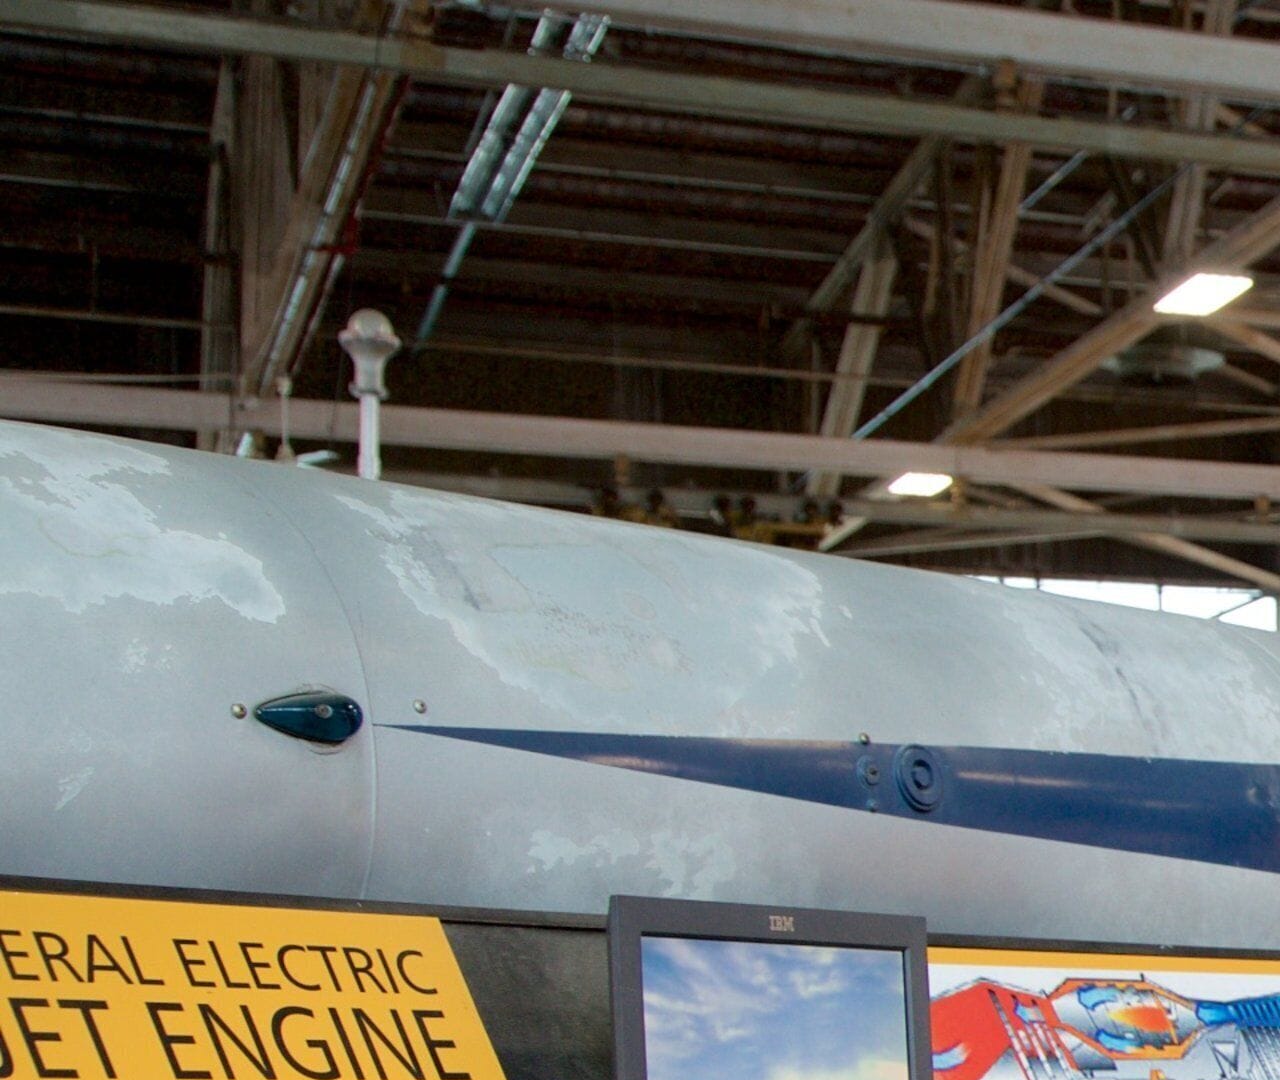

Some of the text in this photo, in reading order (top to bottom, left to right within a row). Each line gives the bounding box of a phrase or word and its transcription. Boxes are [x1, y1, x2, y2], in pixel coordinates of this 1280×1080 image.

[768, 915, 795, 932] IBM
[172, 938, 438, 995] ELECTRIC
[145, 1001, 472, 1080] ENGINE
